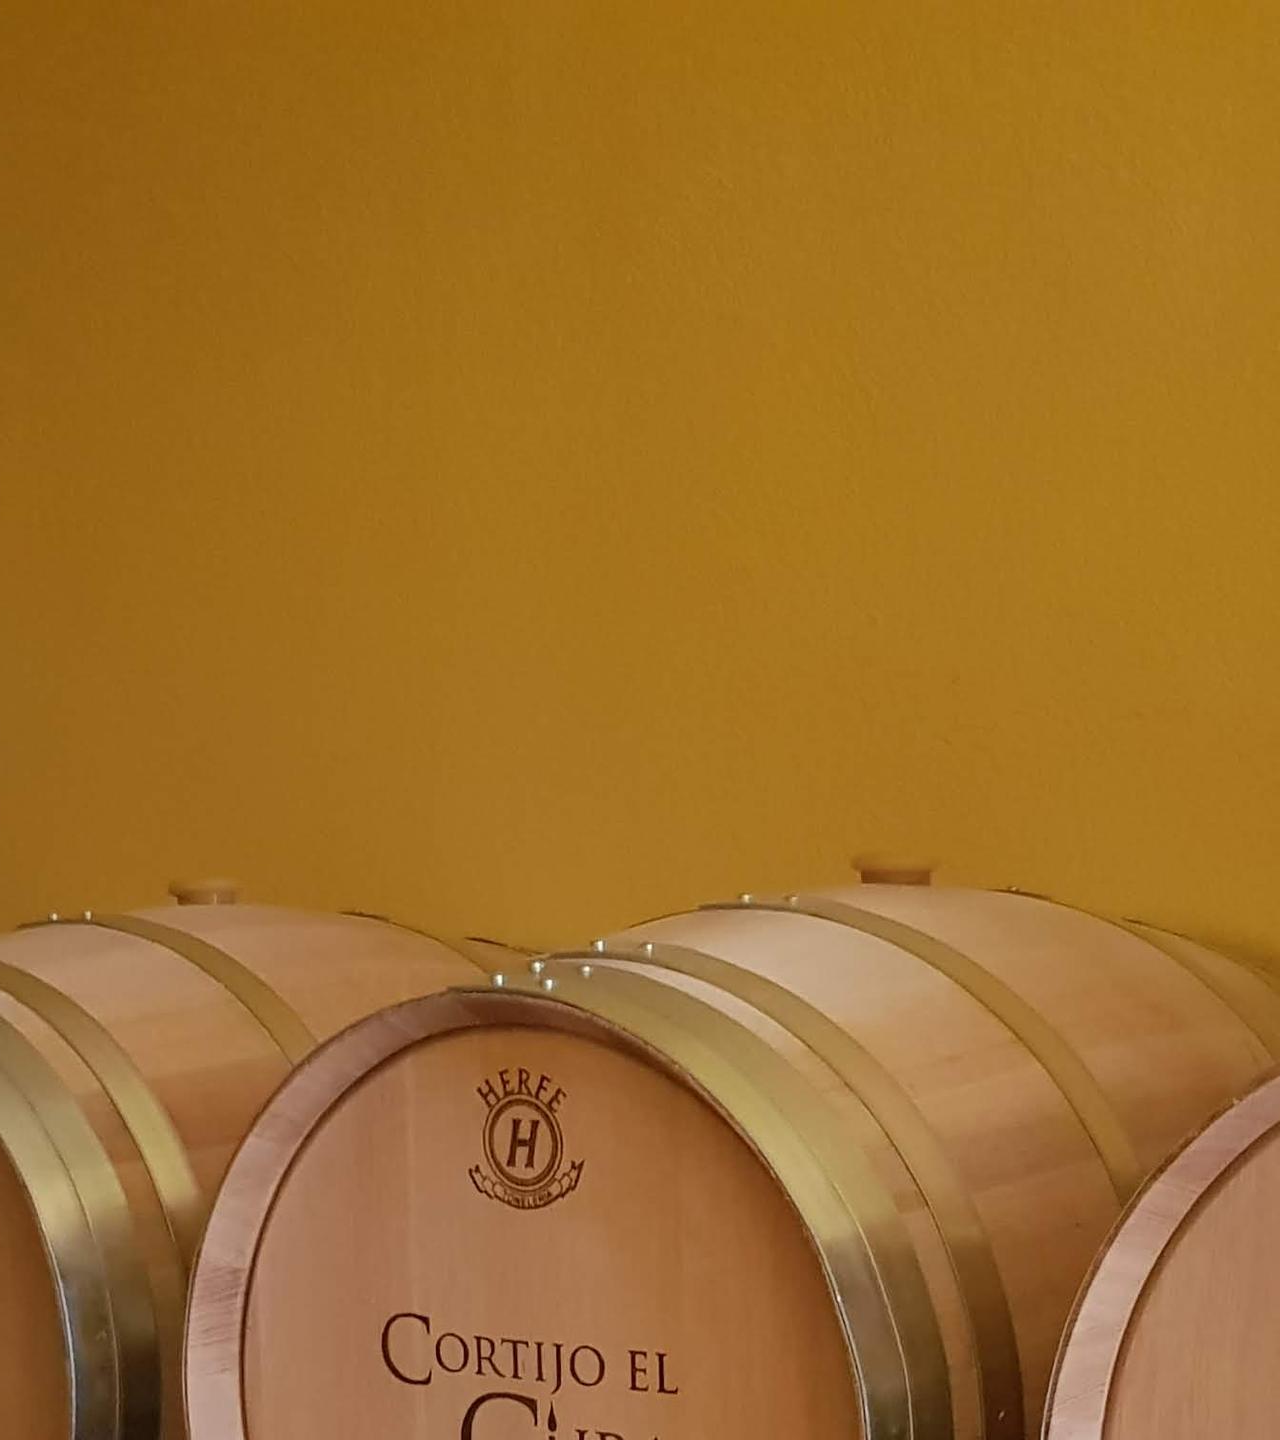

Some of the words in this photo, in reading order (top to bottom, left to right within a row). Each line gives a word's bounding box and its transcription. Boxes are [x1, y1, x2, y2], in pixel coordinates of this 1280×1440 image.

[476, 1067, 568, 1113] HERFE
[506, 1117, 540, 1169] H
[381, 1312, 606, 1395] CORTIJO
[628, 1350, 679, 1395] EL
